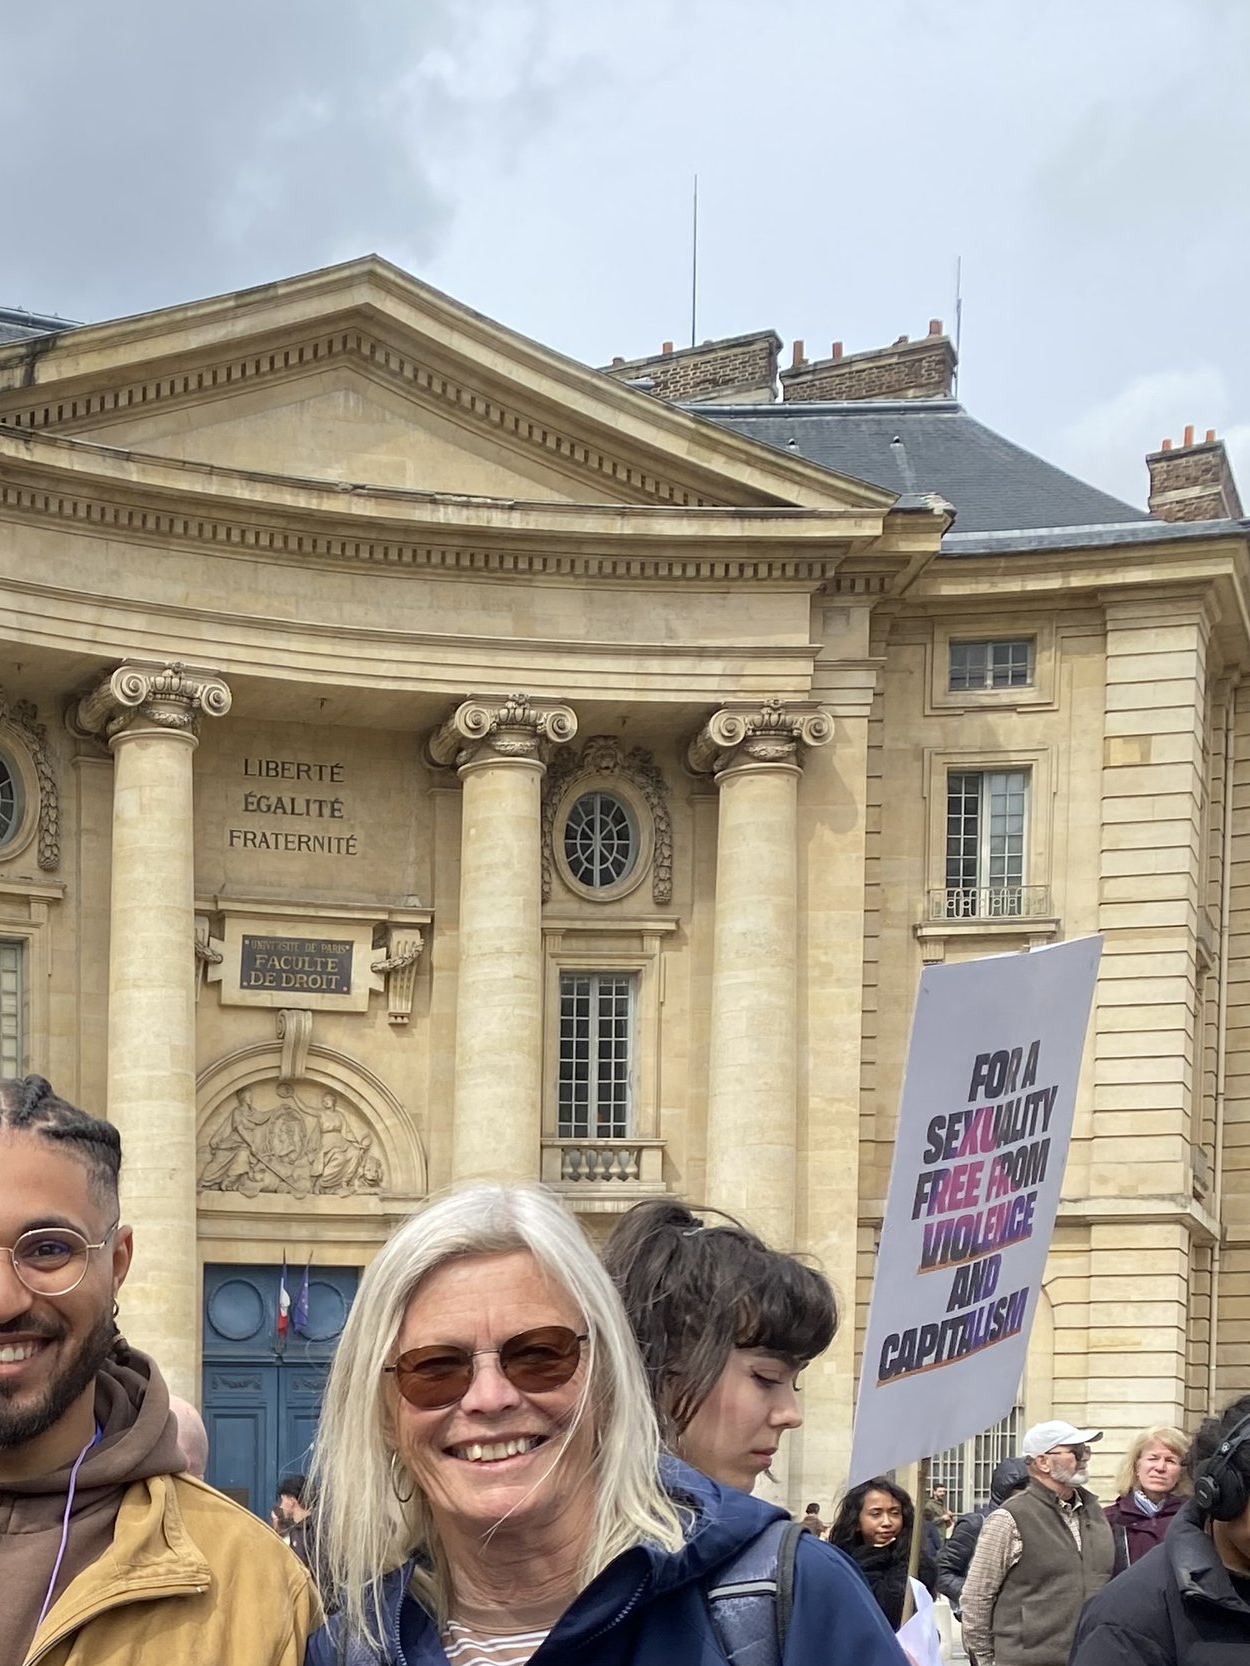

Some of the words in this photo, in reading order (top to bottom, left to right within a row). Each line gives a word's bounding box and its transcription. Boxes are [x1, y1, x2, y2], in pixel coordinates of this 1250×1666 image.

[243, 758, 345, 783] LIBERTÉ
[242, 791, 344, 819] ÉGALITÉ
[228, 829, 358, 856] FRATERNITÉ
[255, 954, 339, 972] FACULTE
[305, 943, 316, 953] DE
[321, 944, 346, 954] PARIS
[250, 971, 276, 986] DE
[281, 973, 340, 989] DROIT
[967, 1044, 1020, 1102] FOR
[1020, 1040, 1041, 1088] A
[923, 1085, 1058, 1166] SEXUALITY
[911, 1160, 983, 1221] FREE
[985, 1138, 1051, 1203] FROM
[920, 1192, 1038, 1269] VIOLENCE
[946, 1254, 1002, 1312] AND
[878, 1287, 1030, 1382] CAPITALISM
